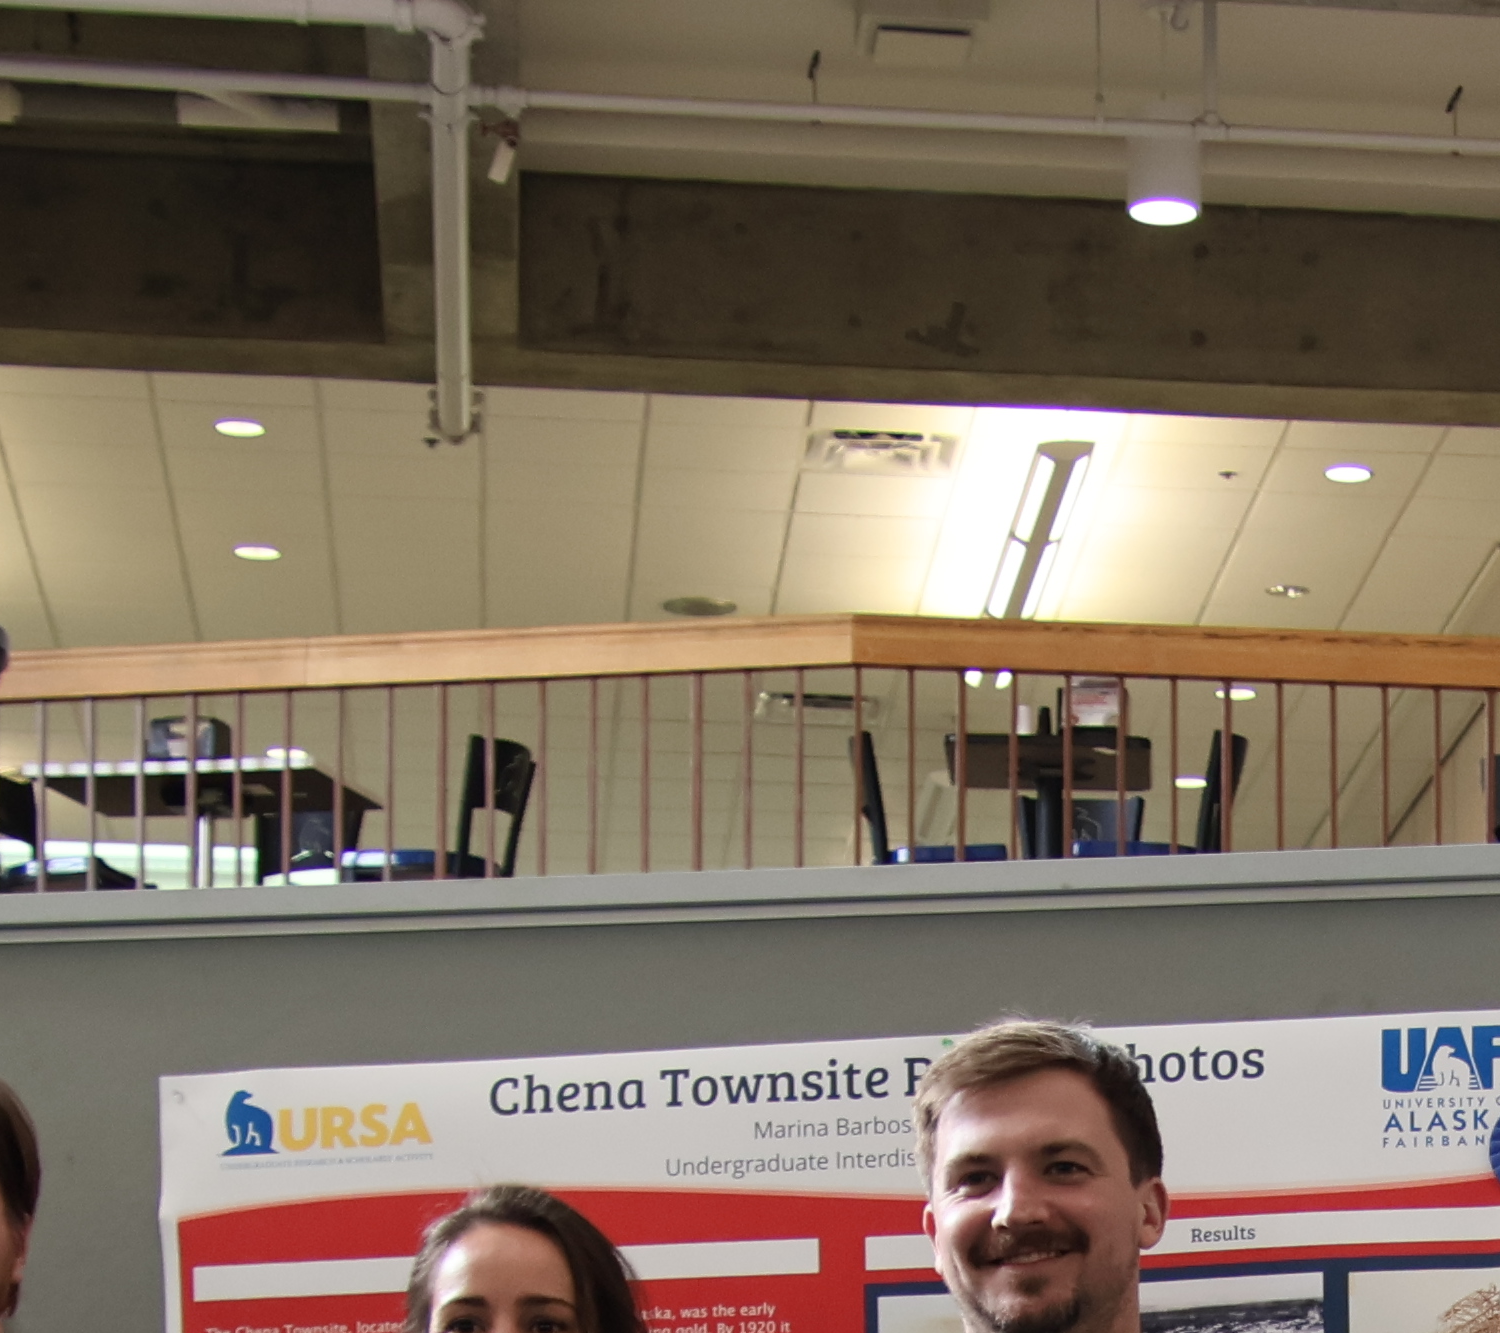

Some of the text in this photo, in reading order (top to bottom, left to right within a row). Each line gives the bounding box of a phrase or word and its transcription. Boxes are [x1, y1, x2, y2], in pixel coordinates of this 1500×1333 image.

[1127, 1044, 1264, 1083] hotos
[490, 1059, 889, 1115] Chena Townsite
[1383, 1100, 1484, 1109] UNIVERSITY
[280, 1102, 432, 1150] URSA
[754, 1116, 912, 1139] Marina Barbos
[1384, 1110, 1488, 1132] ALASK
[1383, 1136, 1485, 1148] FAIRBAN
[666, 1149, 916, 1179] Undergraduate Interdis
[1191, 1225, 1255, 1243] Results
